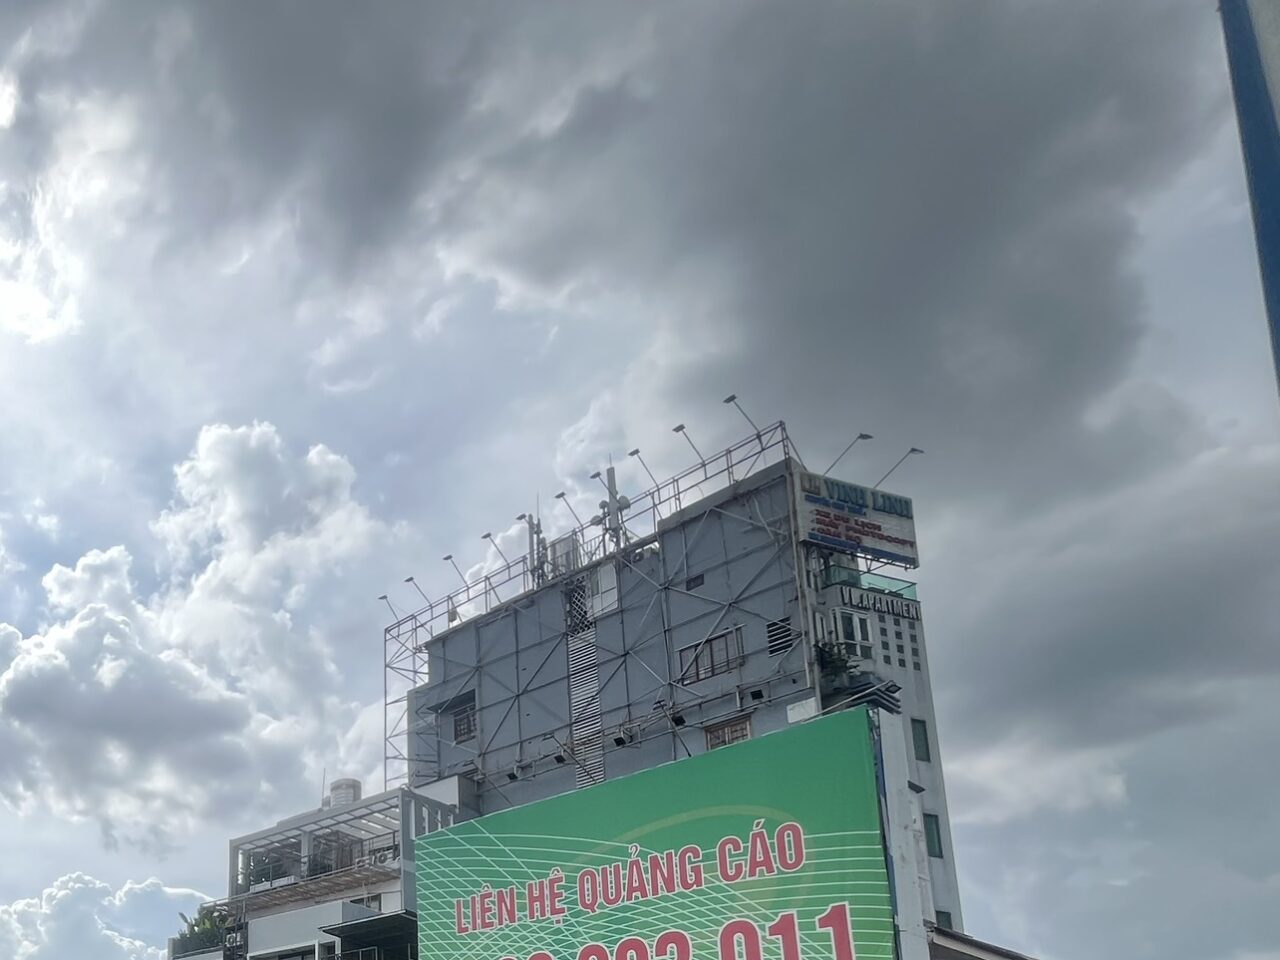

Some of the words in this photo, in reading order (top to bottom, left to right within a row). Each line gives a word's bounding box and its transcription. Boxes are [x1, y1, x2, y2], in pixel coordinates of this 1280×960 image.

[455, 885, 517, 935] LIÊN
[527, 868, 566, 925] HỆ
[577, 843, 704, 912] QUẢNG
[716, 818, 805, 884] CÁO
